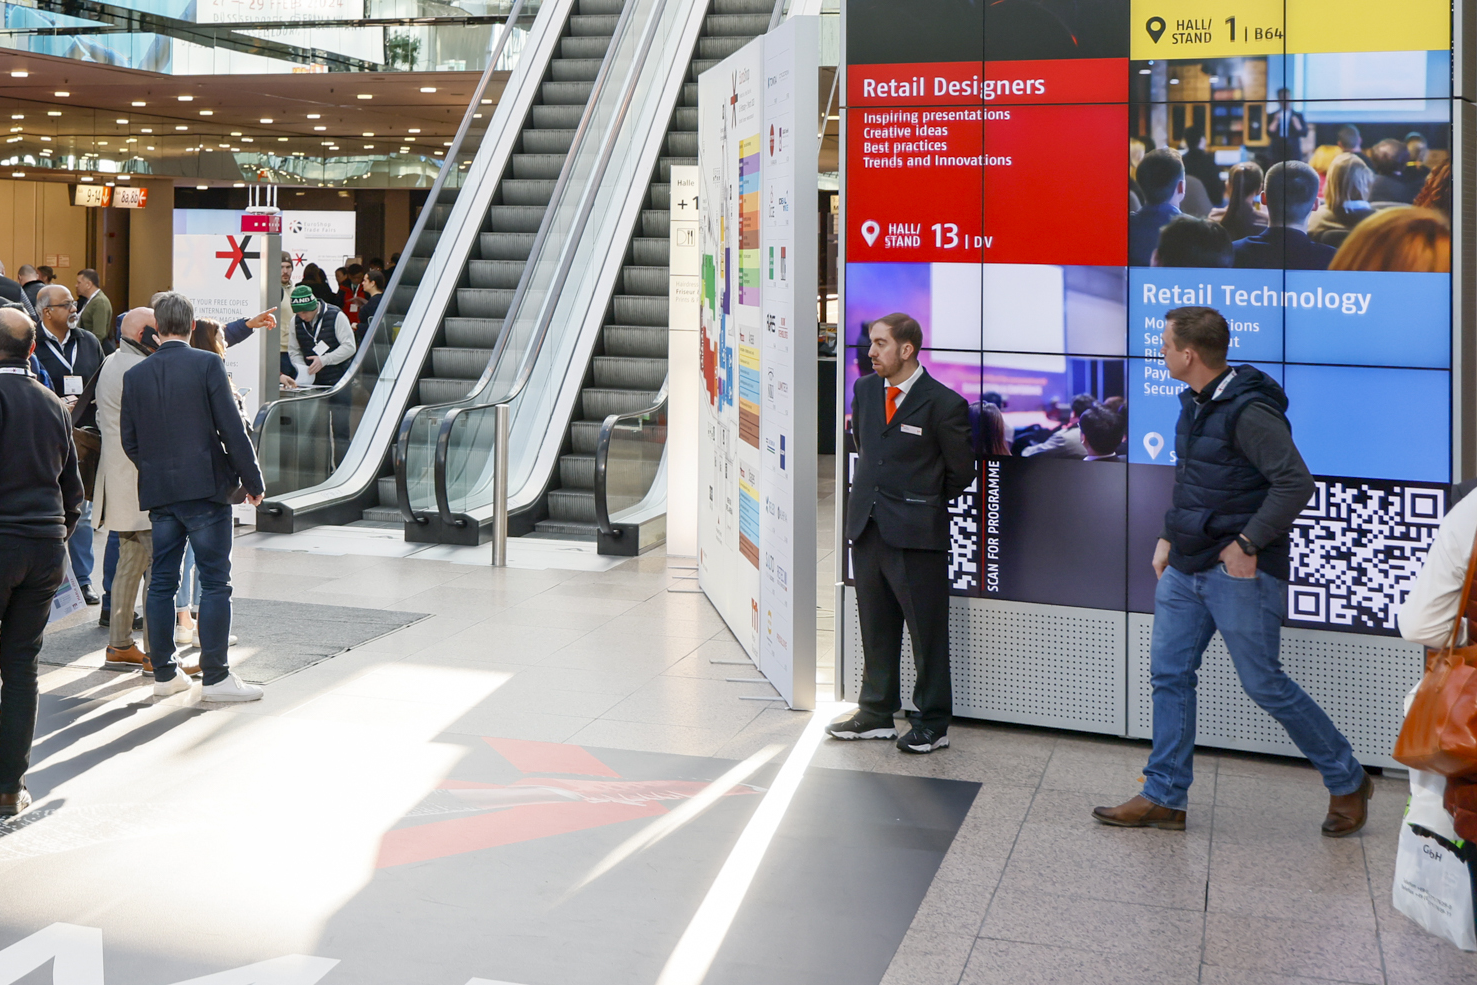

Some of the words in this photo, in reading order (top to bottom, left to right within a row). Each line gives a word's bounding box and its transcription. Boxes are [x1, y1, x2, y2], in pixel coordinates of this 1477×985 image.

[1176, 19, 1212, 31] HALL/
[1225, 15, 1236, 42] 1
[1255, 27, 1284, 40] B64
[1172, 32, 1212, 44] STAND
[863, 77, 924, 97] Retail
[934, 75, 1045, 100] Designers
[864, 110, 919, 125] Inspiring
[922, 109, 1011, 124] presentations
[863, 125, 911, 139] Creative
[915, 125, 948, 136] ideas
[864, 142, 890, 153] Best
[893, 139, 947, 153] practices
[863, 155, 903, 168] Trends
[906, 154, 931, 166] and
[935, 154, 1012, 166] Innovations
[677, 179, 695, 187] Halle
[888, 223, 921, 235] HALL/
[931, 222, 959, 249] 13
[884, 235, 921, 248] STAND
[1143, 283, 1212, 305] Retail
[1221, 285, 1372, 315] Technology
[987, 460, 1000, 534] PROGRAMME
[987, 537, 999, 559] FOR
[987, 563, 999, 592] SCAN
